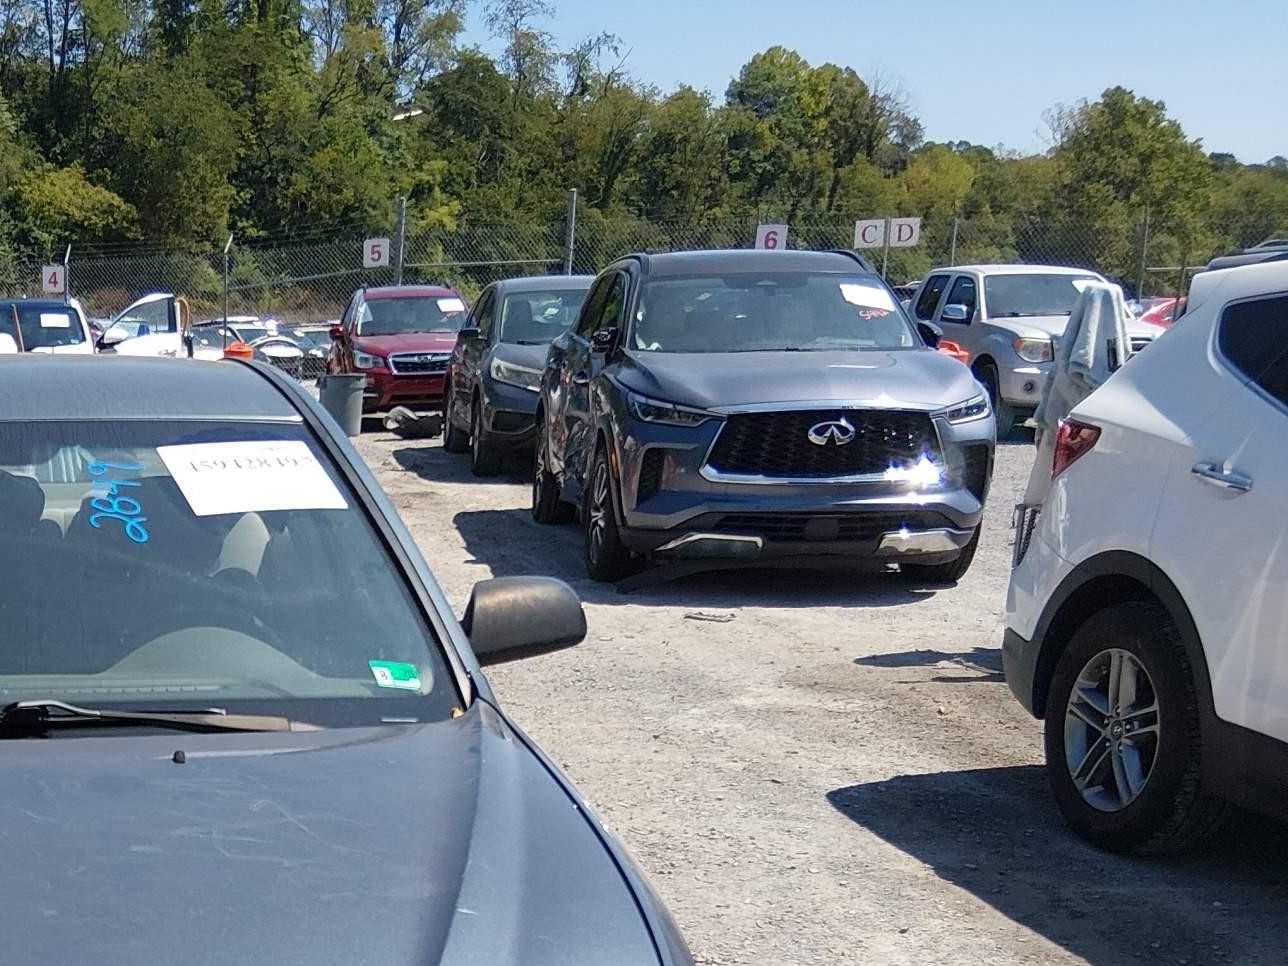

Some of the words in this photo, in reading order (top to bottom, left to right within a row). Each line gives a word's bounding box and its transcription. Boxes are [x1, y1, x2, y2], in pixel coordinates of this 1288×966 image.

[764, 230, 779, 250] 6
[861, 224, 878, 244] C
[896, 223, 914, 243] D
[370, 244, 382, 262] 5
[48, 271, 59, 288] 4
[87, 460, 149, 543] 2849
